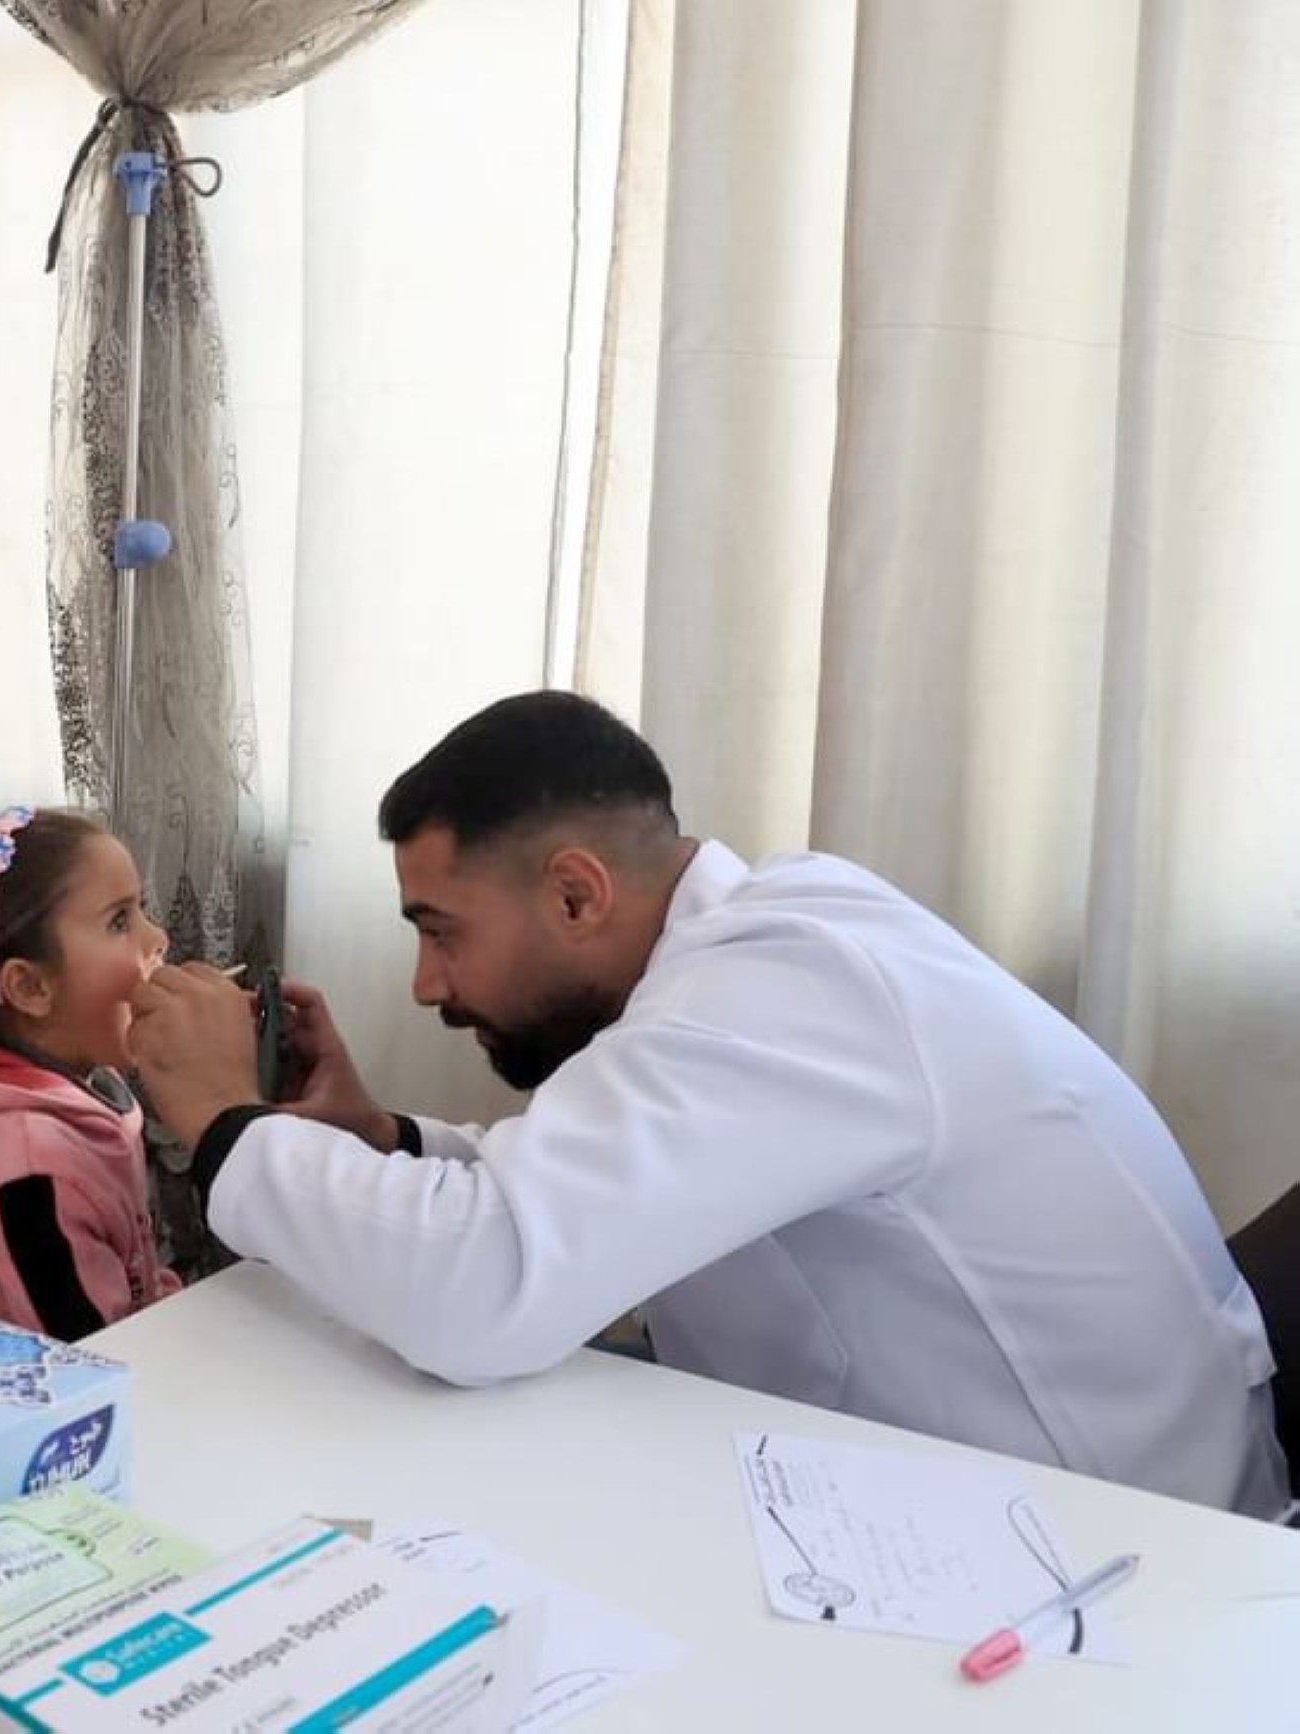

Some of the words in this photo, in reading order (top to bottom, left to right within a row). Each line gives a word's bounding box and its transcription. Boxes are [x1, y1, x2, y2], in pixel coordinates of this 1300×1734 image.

[139, 1679, 223, 1727] Sterile
[211, 1636, 299, 1683] Tongue
[285, 1581, 388, 1642] Depressor
